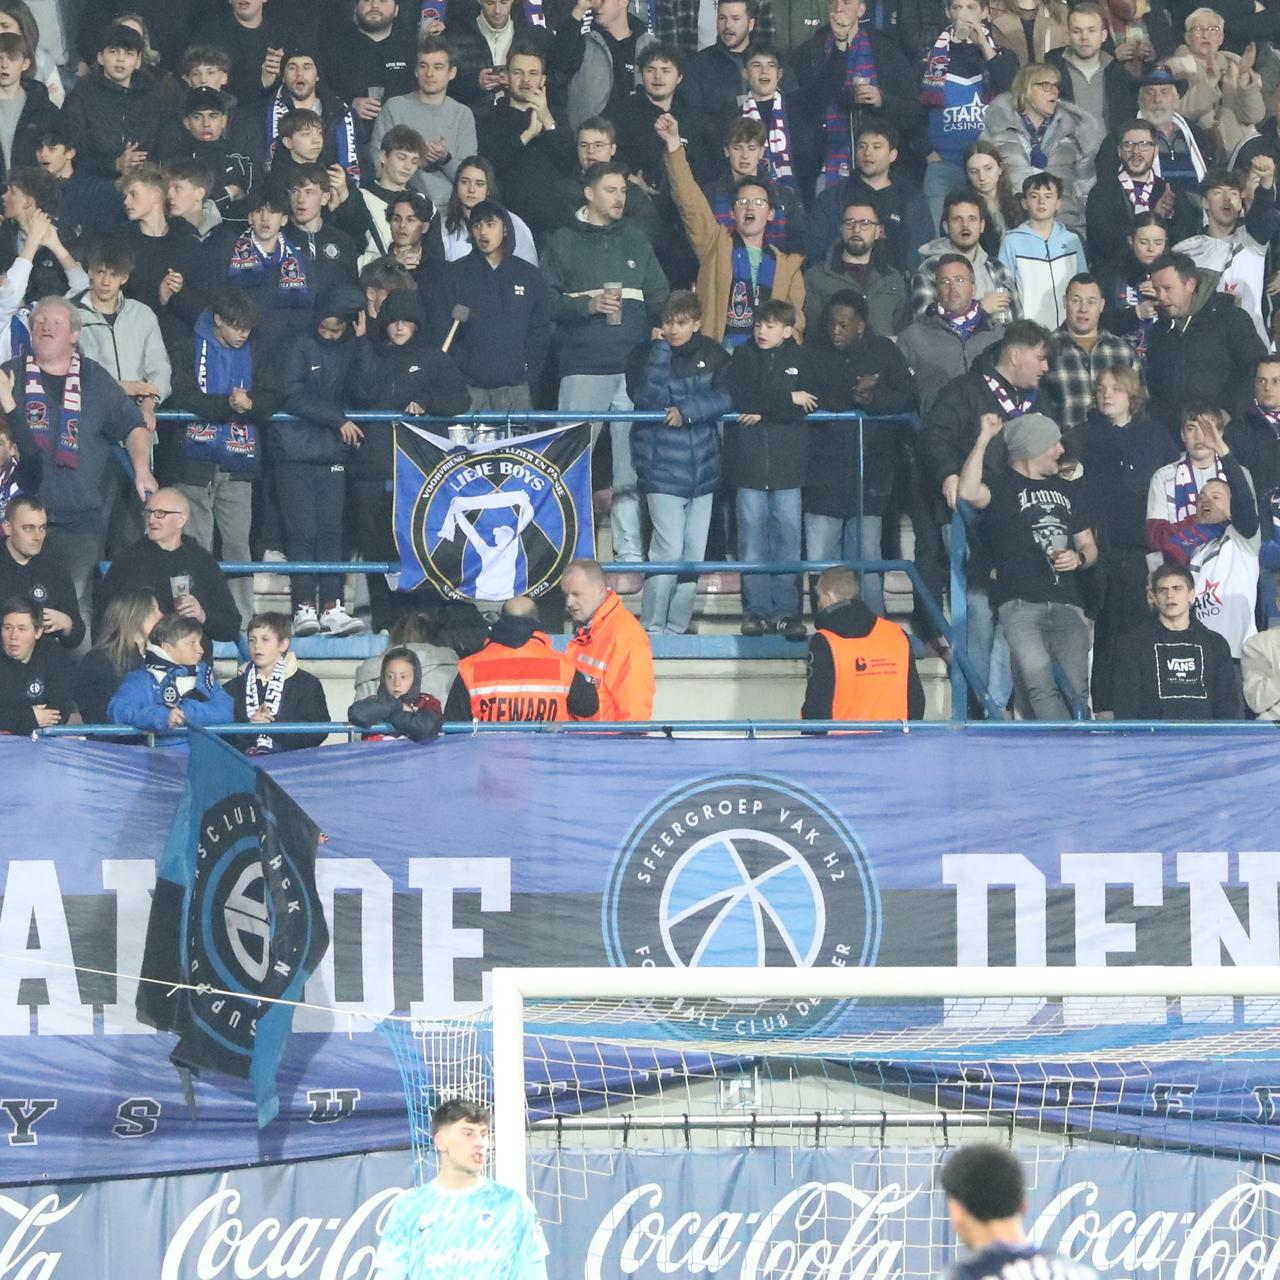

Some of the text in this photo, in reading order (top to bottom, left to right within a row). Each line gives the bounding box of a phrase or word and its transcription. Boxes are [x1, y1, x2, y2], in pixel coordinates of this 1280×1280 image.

[943, 121, 986, 132] CASINO
[449, 461, 545, 492] LIEJE BOYS
[1017, 487, 1073, 516] Lemmy
[1166, 657, 1196, 672] VANS
[480, 694, 558, 722] STEWARD
[636, 798, 846, 885] SFEERGROEP VAK H2
[734, 1012, 789, 1036] CLUB
[584, 1180, 923, 1280] Coca-Cola
